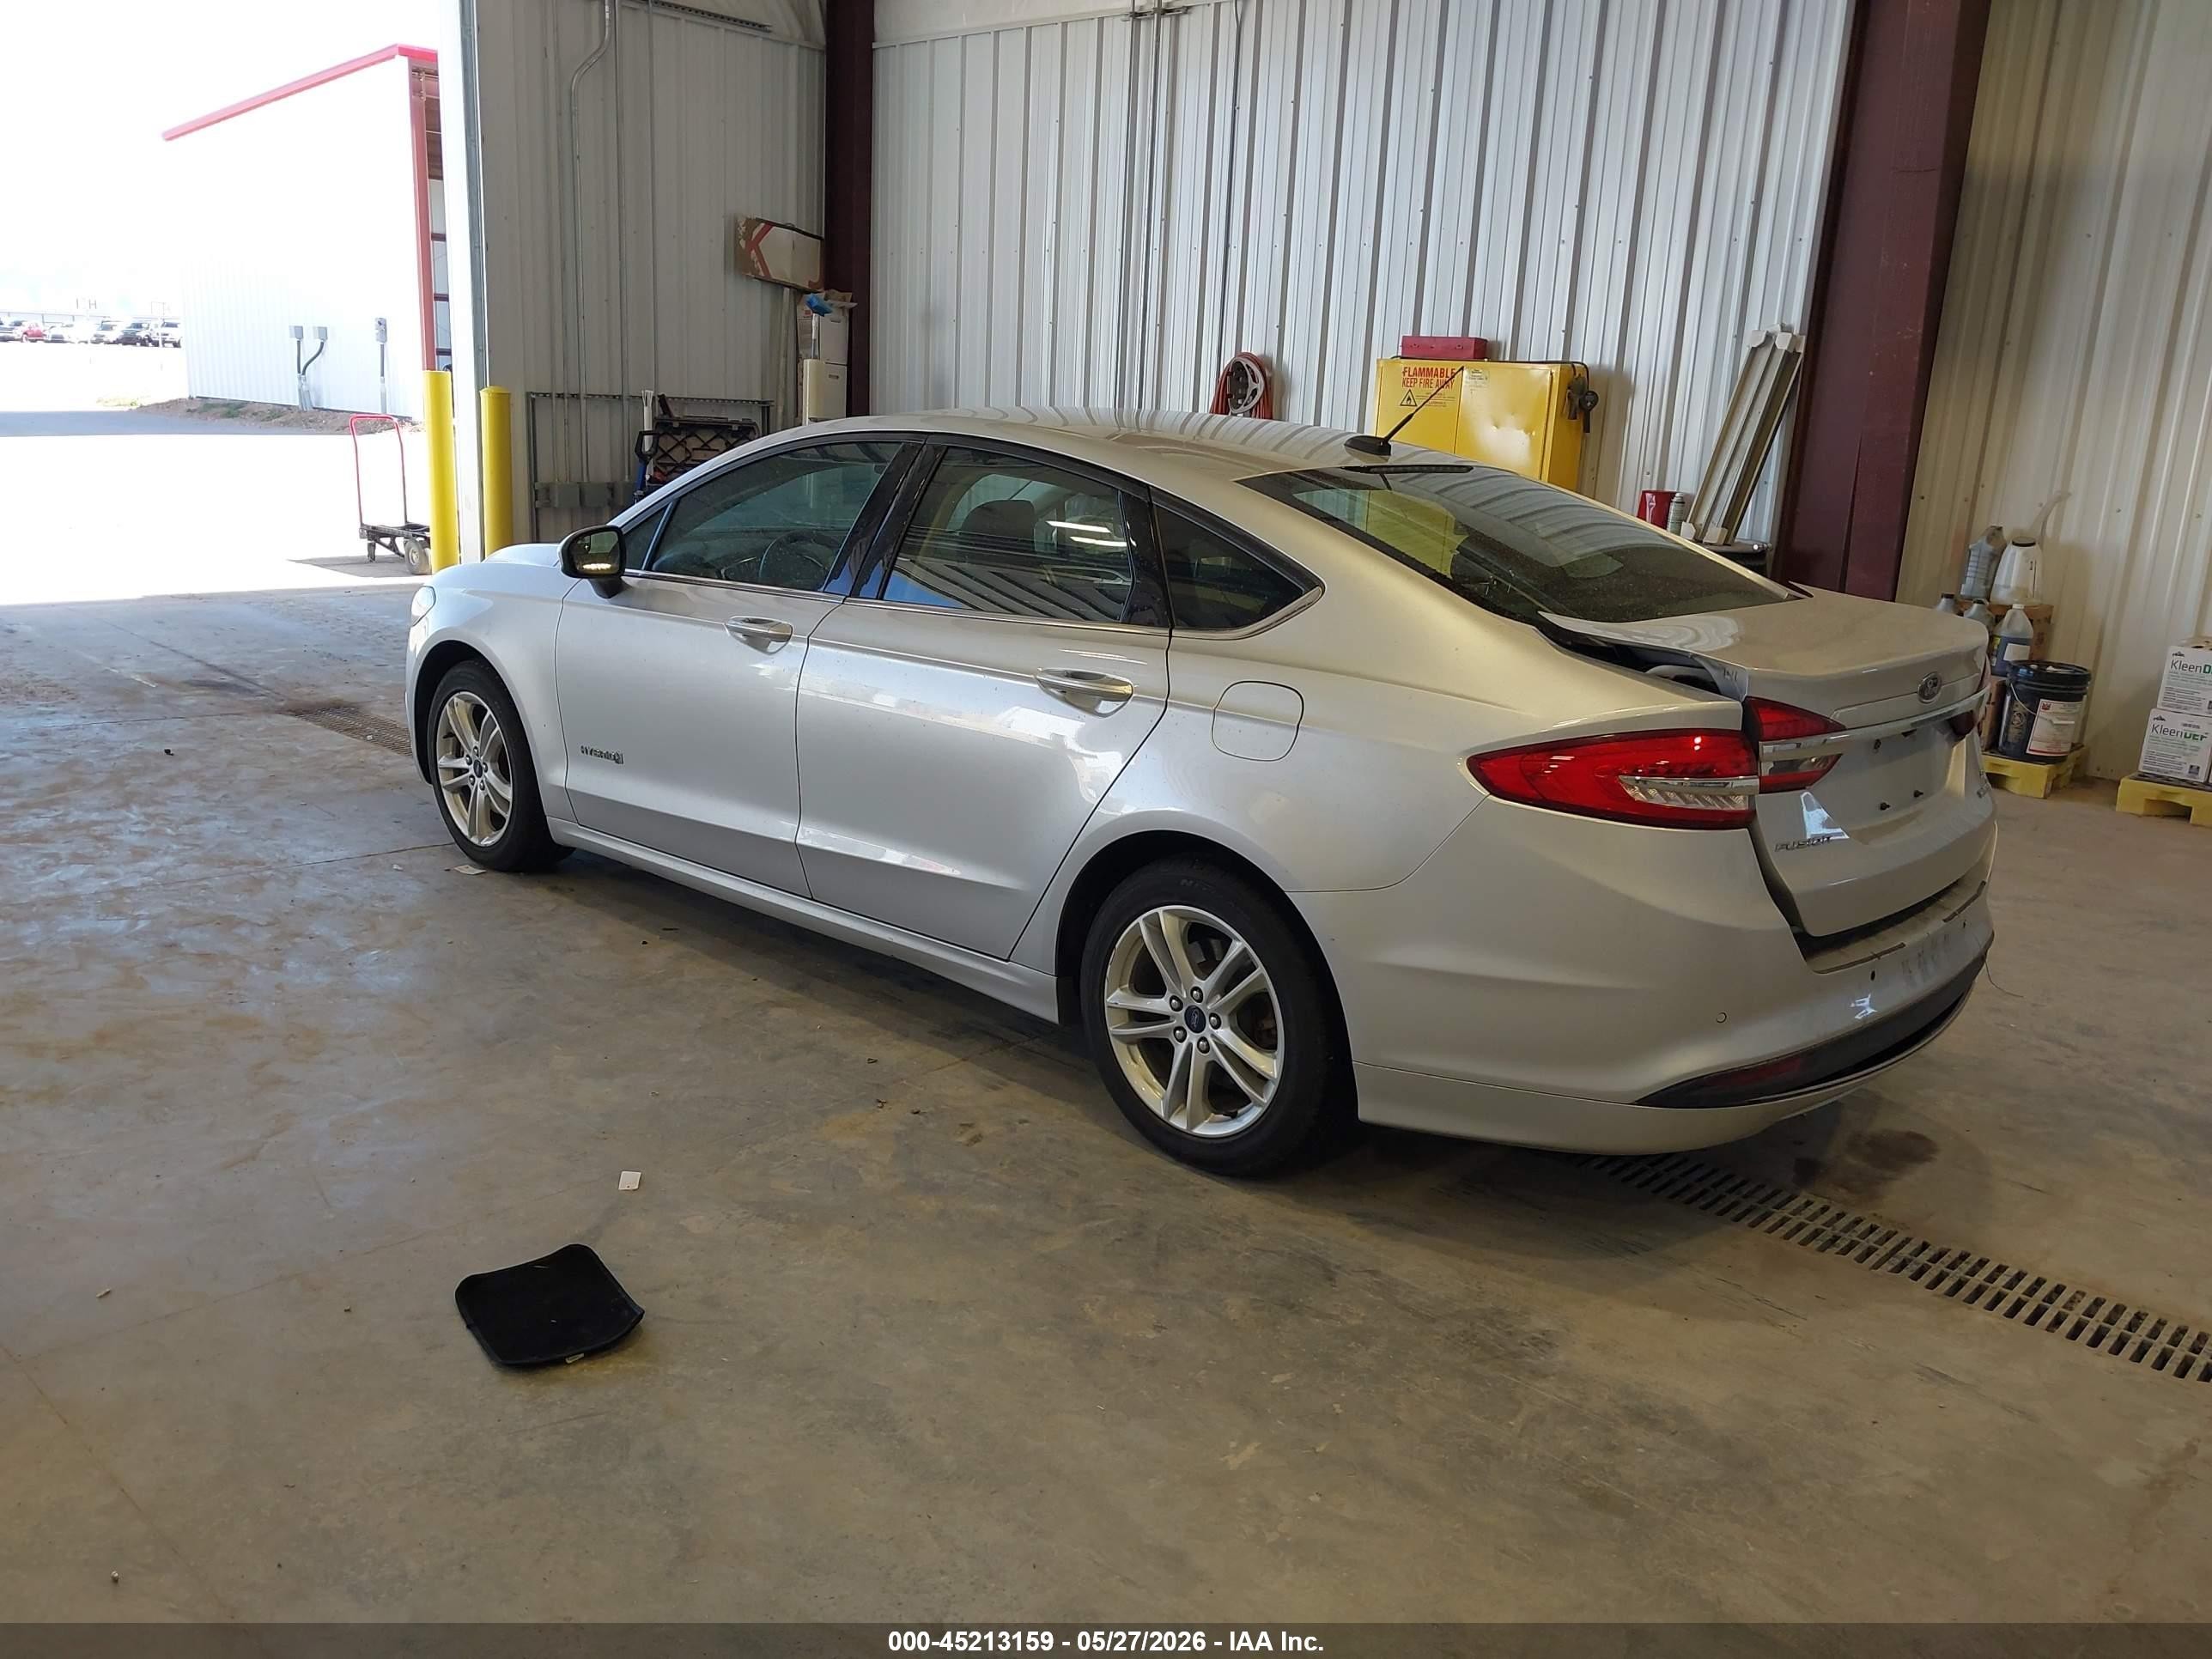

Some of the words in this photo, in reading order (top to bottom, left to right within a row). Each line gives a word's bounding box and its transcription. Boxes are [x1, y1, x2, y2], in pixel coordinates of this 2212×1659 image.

[1402, 367, 1456, 378] FLAMMABLE
[1401, 378, 1418, 388] KEEP
[1419, 378, 1434, 389] FIRE
[1435, 379, 1455, 390] AWAY
[2170, 659, 2212, 674] KleenD
